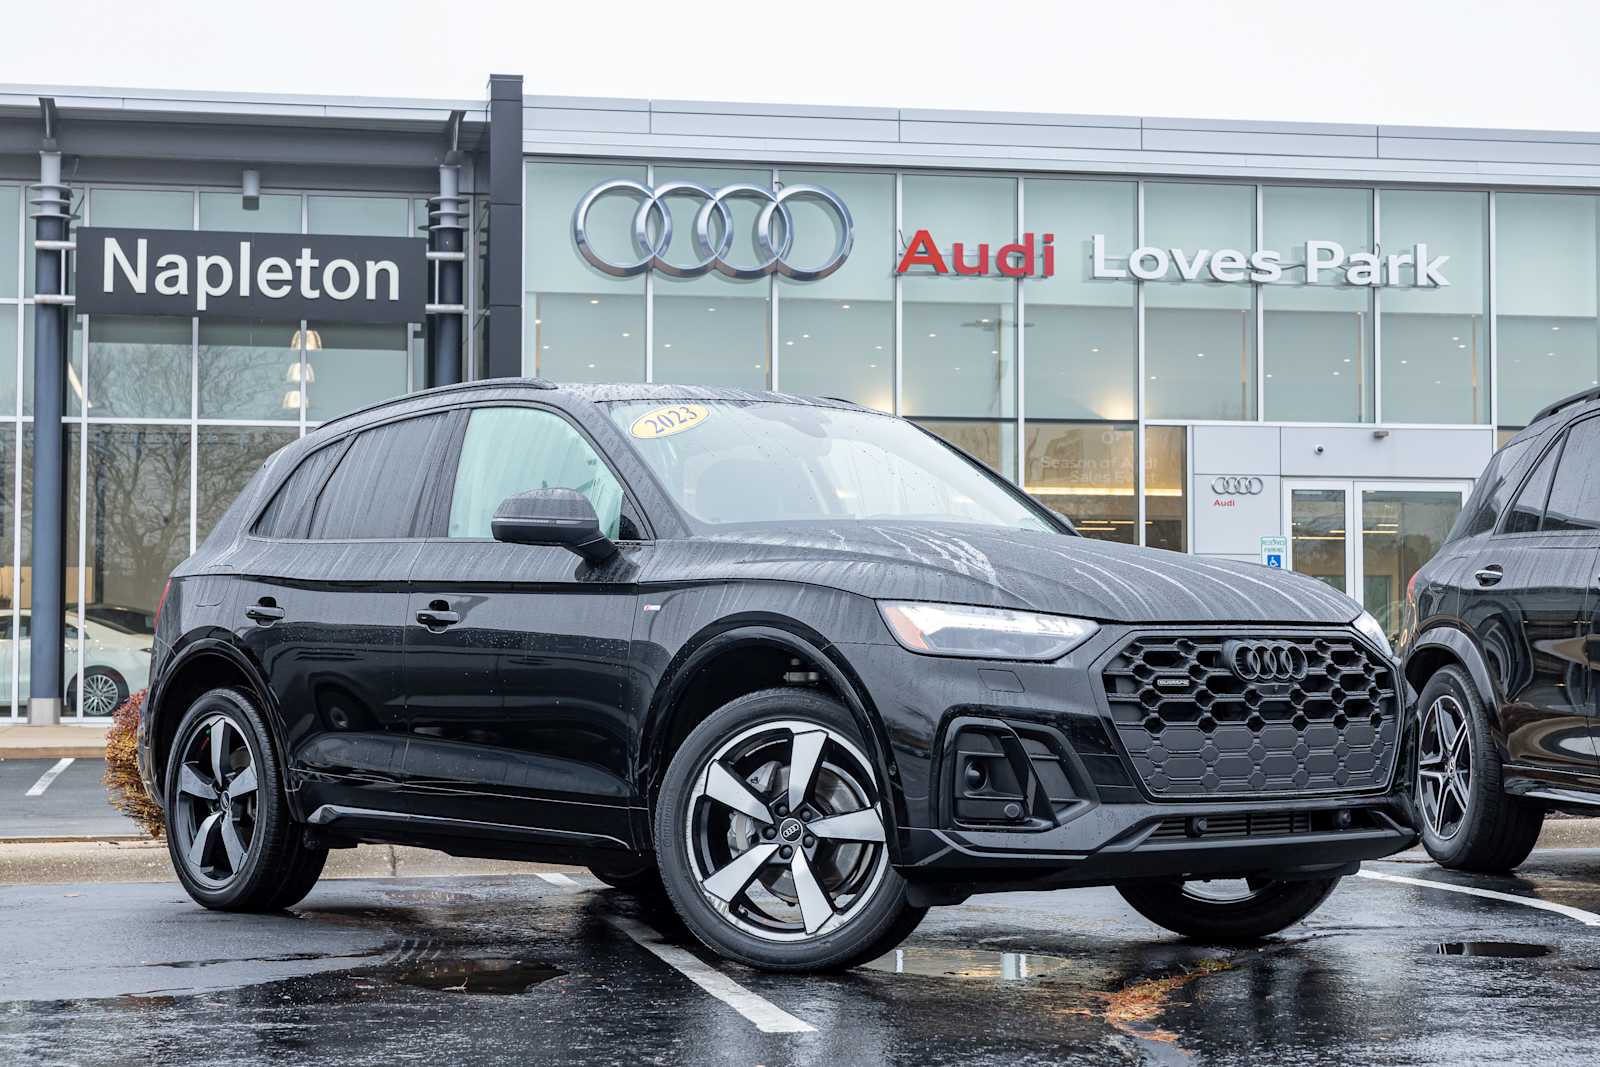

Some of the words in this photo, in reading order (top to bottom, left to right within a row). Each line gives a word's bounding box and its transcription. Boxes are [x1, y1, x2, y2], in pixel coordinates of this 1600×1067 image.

[896, 230, 1054, 277] Audi
[1093, 234, 1282, 282] Loves
[1305, 240, 1451, 286] Park
[103, 237, 399, 311] Napleton
[644, 406, 698, 434] 2023
[1120, 457, 1157, 470] Adi
[1214, 499, 1235, 507] Audi
